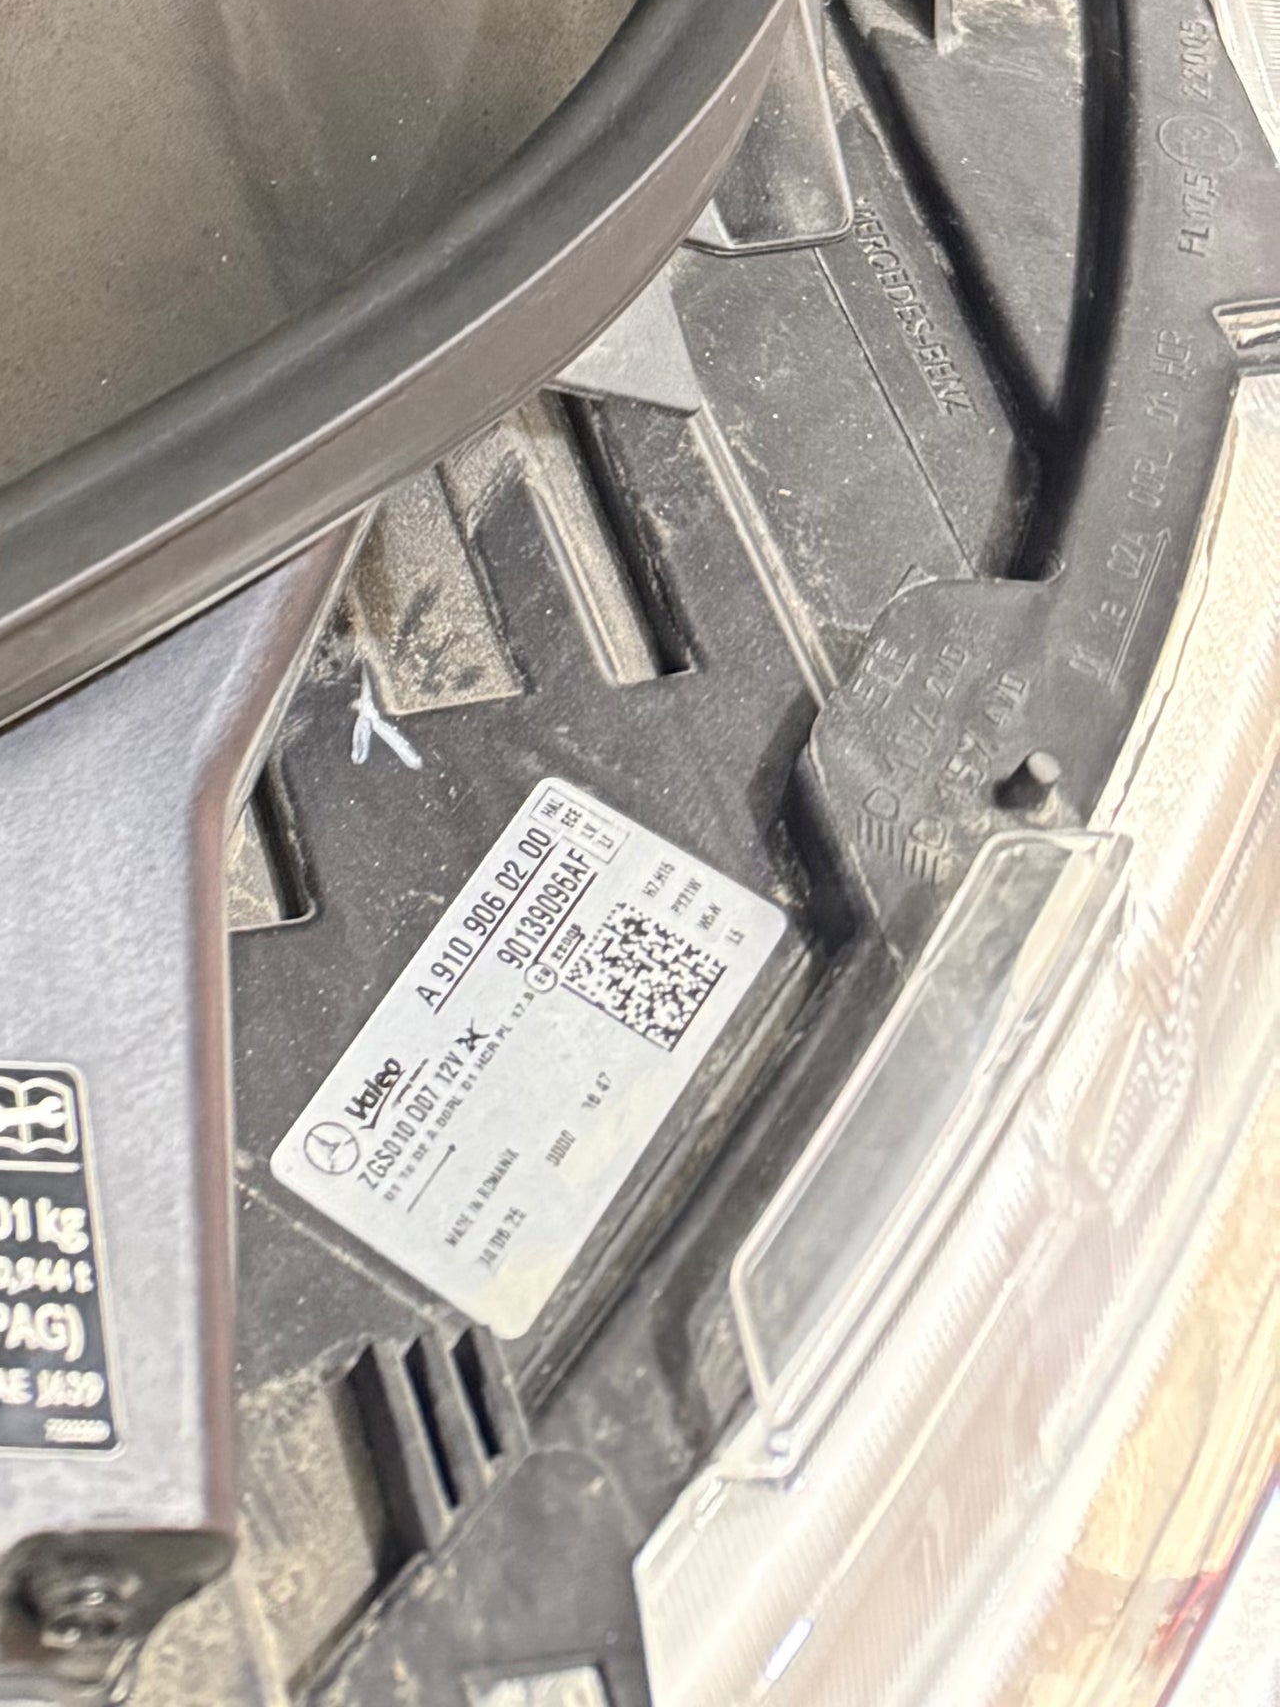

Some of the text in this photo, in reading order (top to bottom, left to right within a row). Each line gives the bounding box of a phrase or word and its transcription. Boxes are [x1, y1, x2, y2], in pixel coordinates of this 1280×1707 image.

[414, 824, 553, 1009] A 910 906 02 00
[495, 847, 595, 971] 90139096AF
[345, 1057, 402, 1121] Valeo
[431, 1049, 467, 1087] 12V
[35, 1197, 90, 1254] kg
